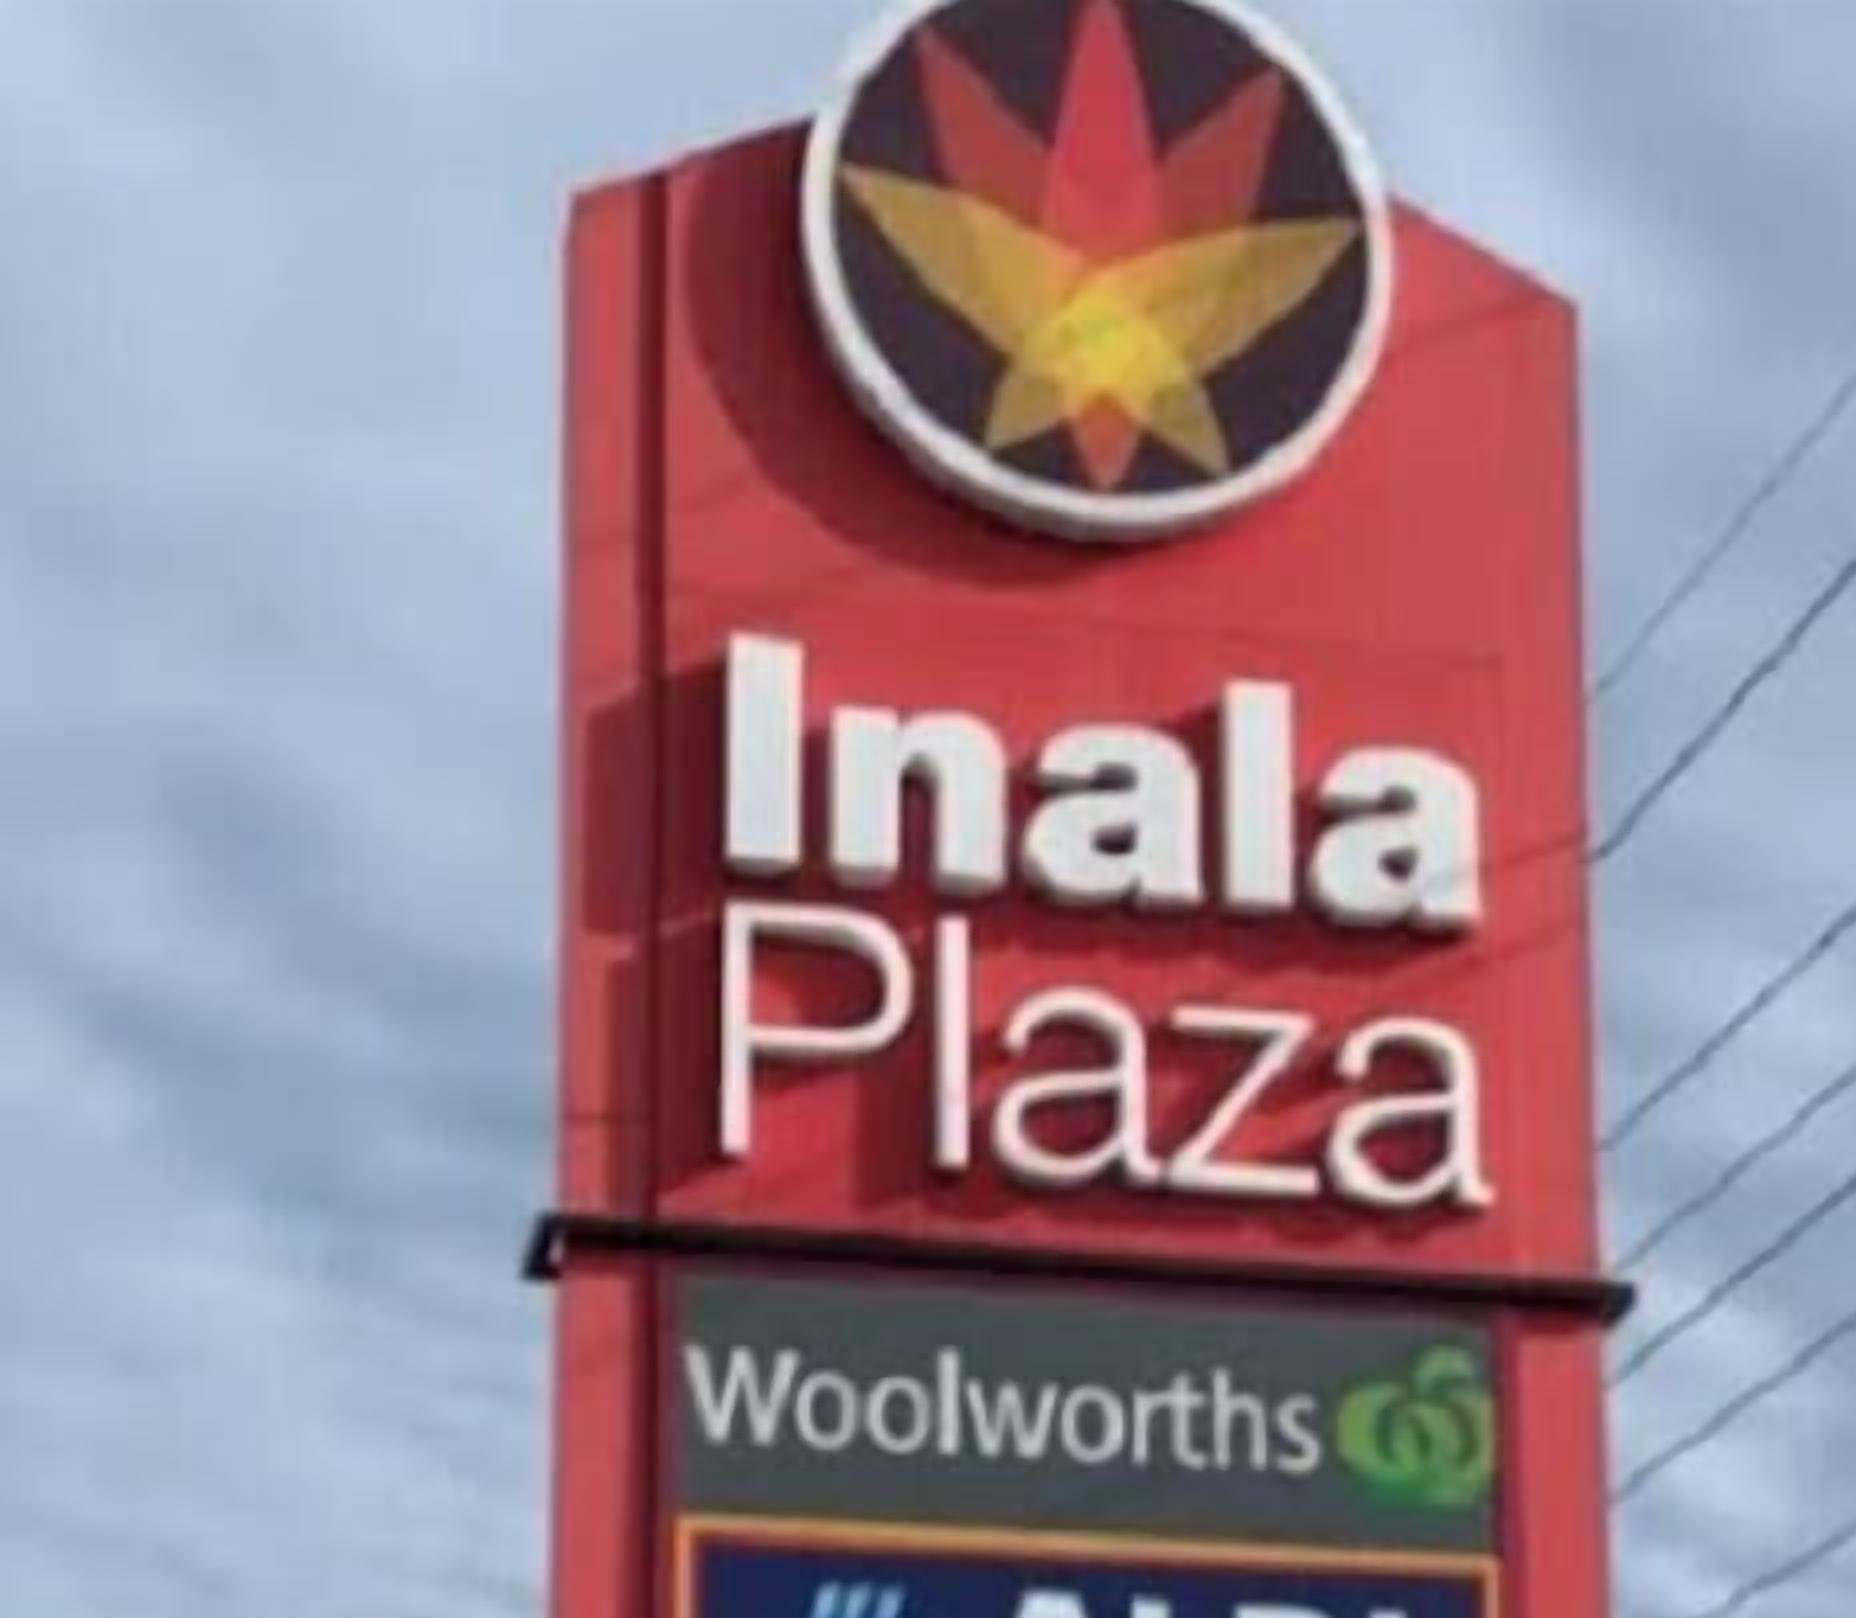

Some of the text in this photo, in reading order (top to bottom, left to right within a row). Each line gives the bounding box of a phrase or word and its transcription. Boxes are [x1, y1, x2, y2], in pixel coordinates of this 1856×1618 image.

[724, 632, 1483, 932] Inala
[719, 901, 1494, 1210] Plaza
[684, 1344, 1323, 1474] Woolworths
